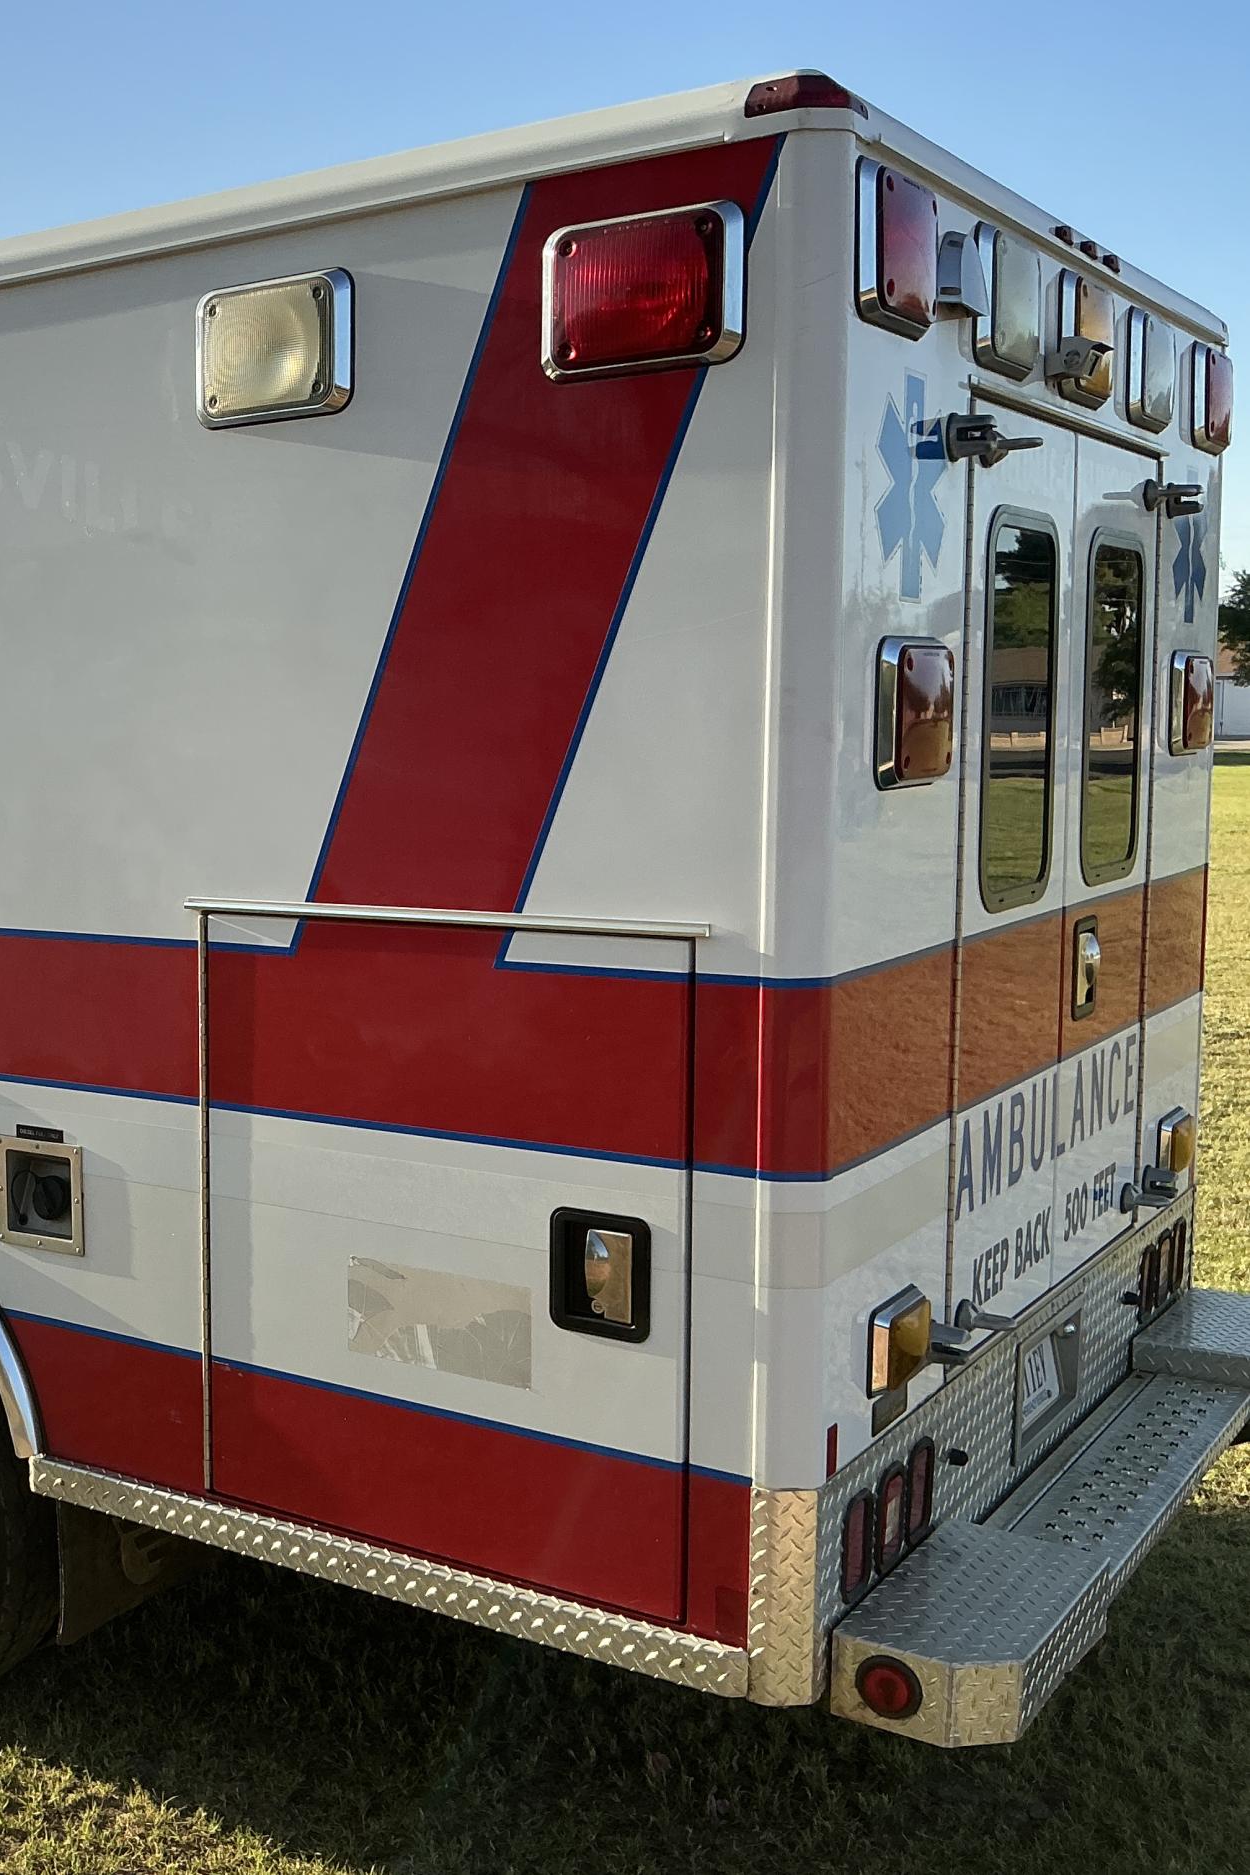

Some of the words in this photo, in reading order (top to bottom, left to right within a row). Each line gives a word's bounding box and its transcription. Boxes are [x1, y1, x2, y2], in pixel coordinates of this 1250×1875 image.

[954, 1032, 1137, 1222] AMBULANCE
[972, 1237, 1010, 1306] KEEP
[1014, 1205, 1052, 1281] BACK
[1063, 1181, 1089, 1243] 500
[1091, 1161, 1117, 1223] FEET
